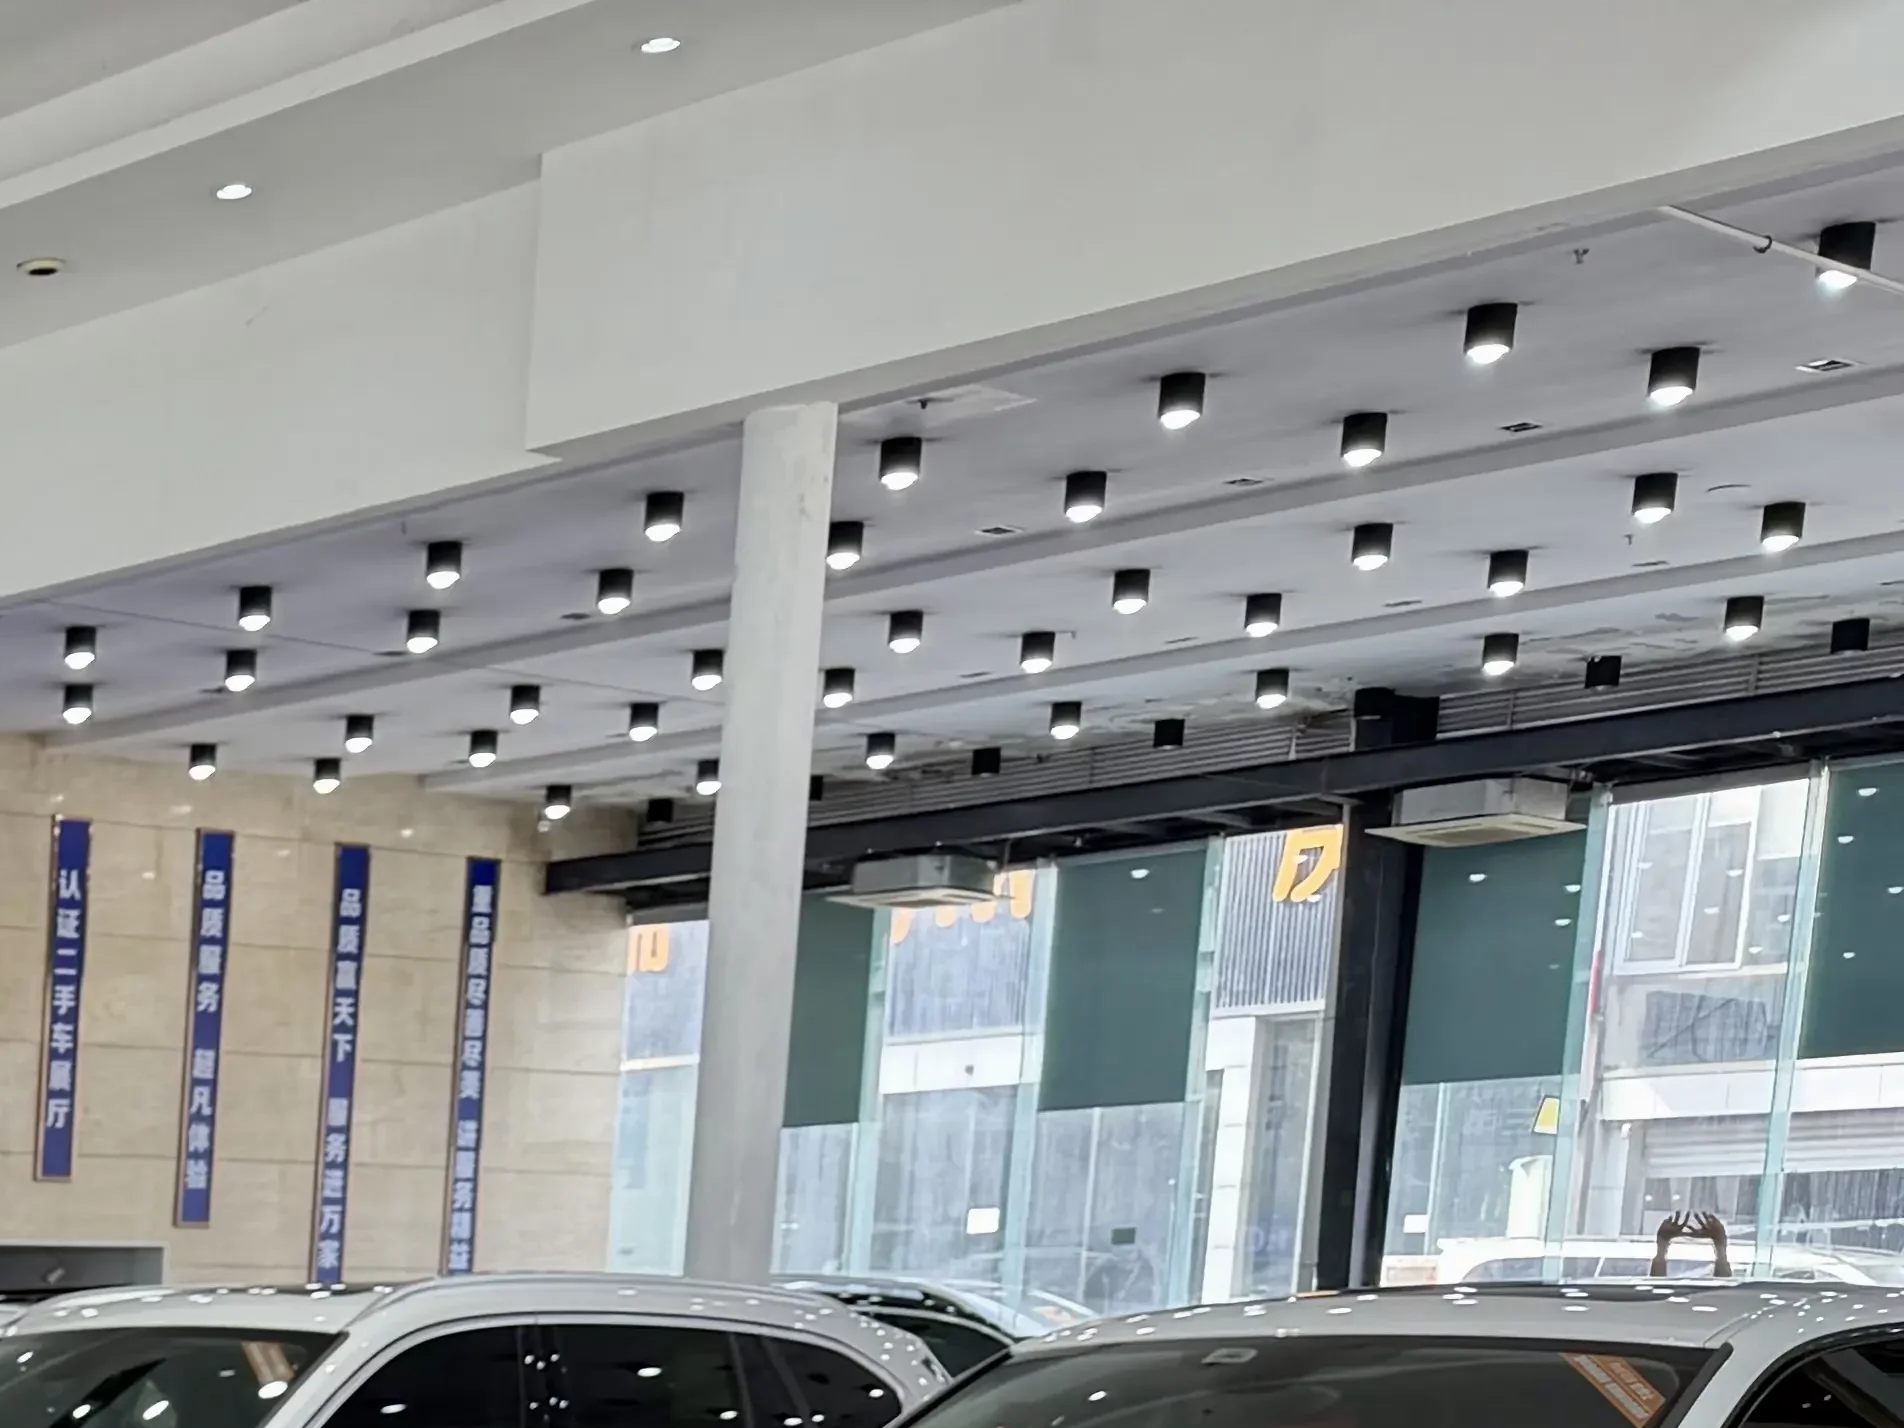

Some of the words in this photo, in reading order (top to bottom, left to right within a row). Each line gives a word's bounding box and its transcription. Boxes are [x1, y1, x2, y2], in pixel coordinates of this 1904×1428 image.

[46, 868, 82, 1129] 认证二手车展厅
[195, 869, 227, 1013] 品质服务
